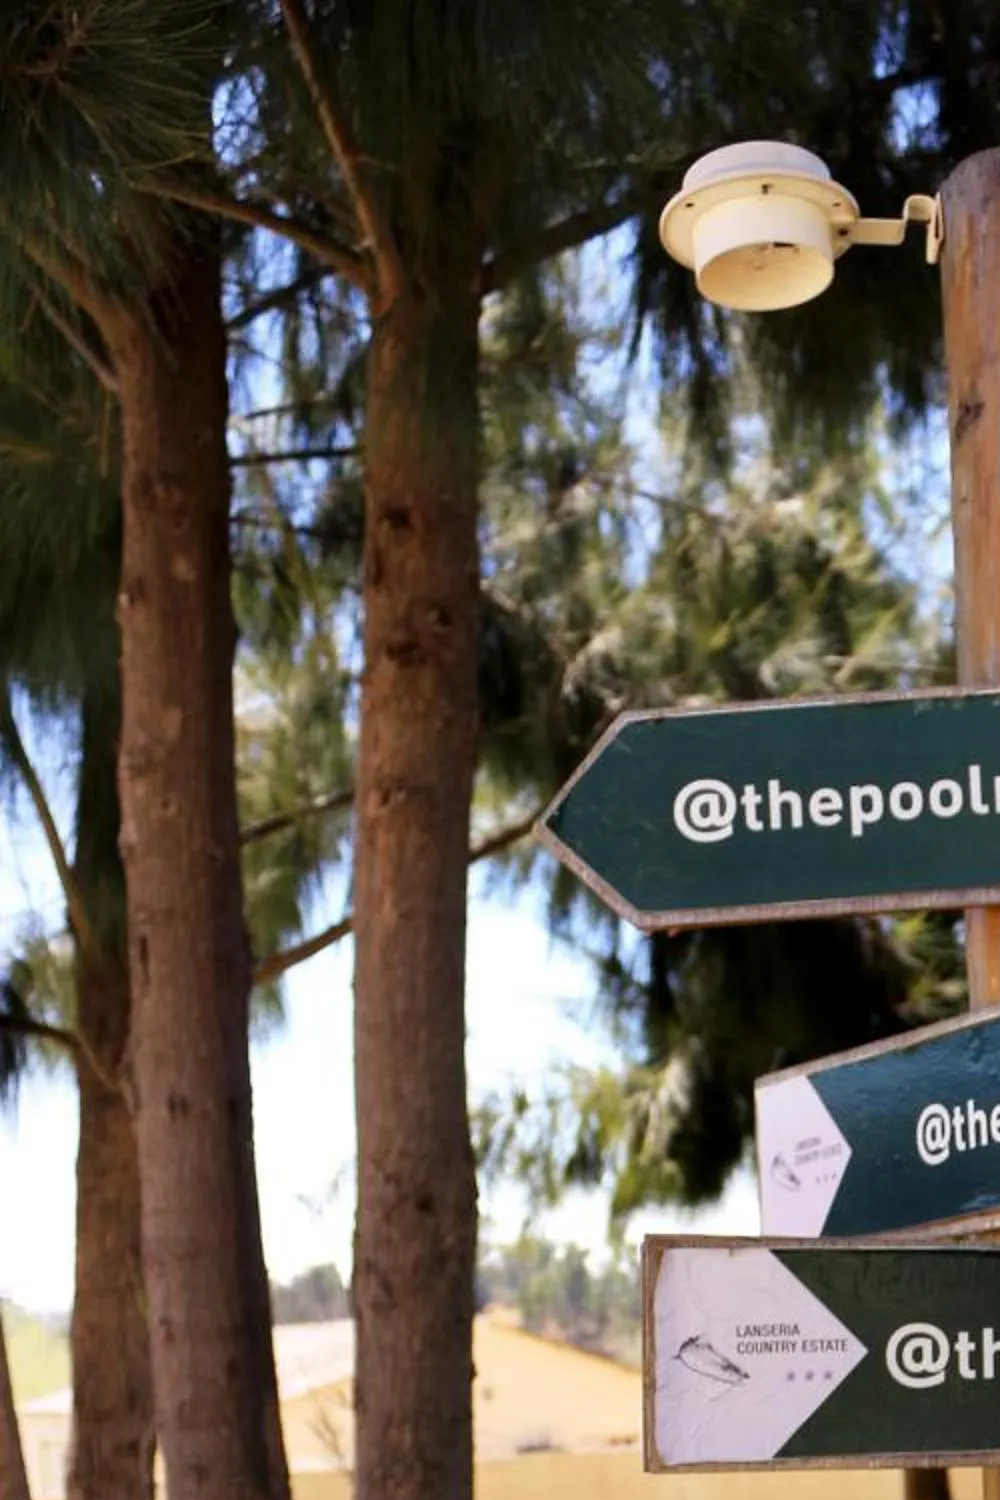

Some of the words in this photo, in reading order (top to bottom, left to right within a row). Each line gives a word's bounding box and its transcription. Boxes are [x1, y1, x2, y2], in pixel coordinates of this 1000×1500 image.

[735, 1323, 801, 1338] LANSERIA
[736, 1340, 798, 1355] COUNTRY
[801, 1338, 849, 1353] ESTATE
